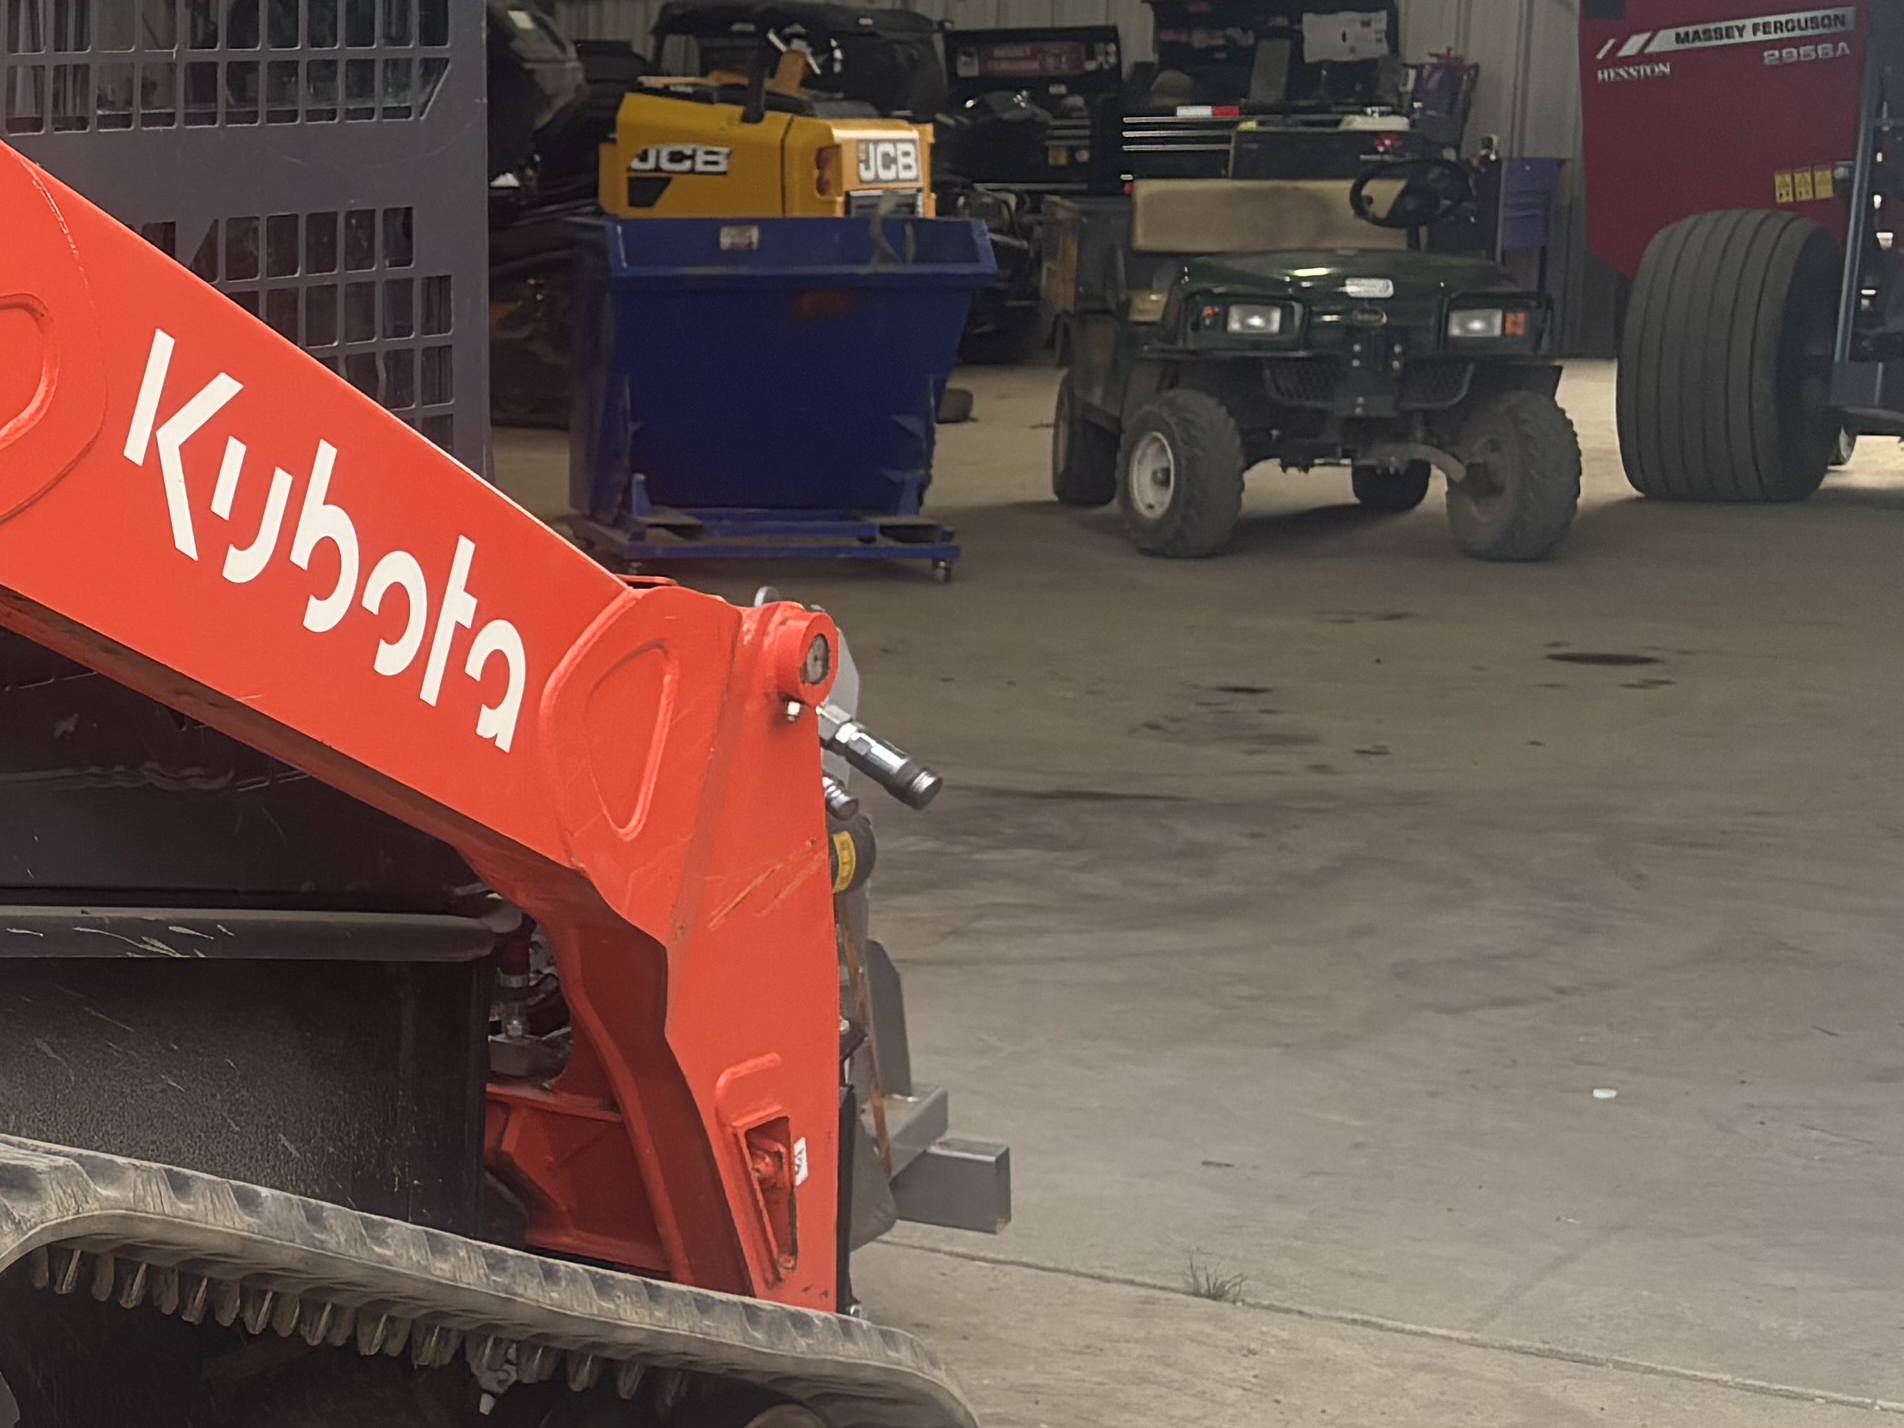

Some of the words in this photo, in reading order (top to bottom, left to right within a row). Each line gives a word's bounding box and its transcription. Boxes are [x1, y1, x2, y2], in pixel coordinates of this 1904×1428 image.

[1675, 23, 1746, 45] MASSEY
[1752, 12, 1846, 37] FERGUSON
[631, 146, 729, 173] JCB
[859, 141, 918, 181] JCB
[123, 328, 526, 753] Kubota
